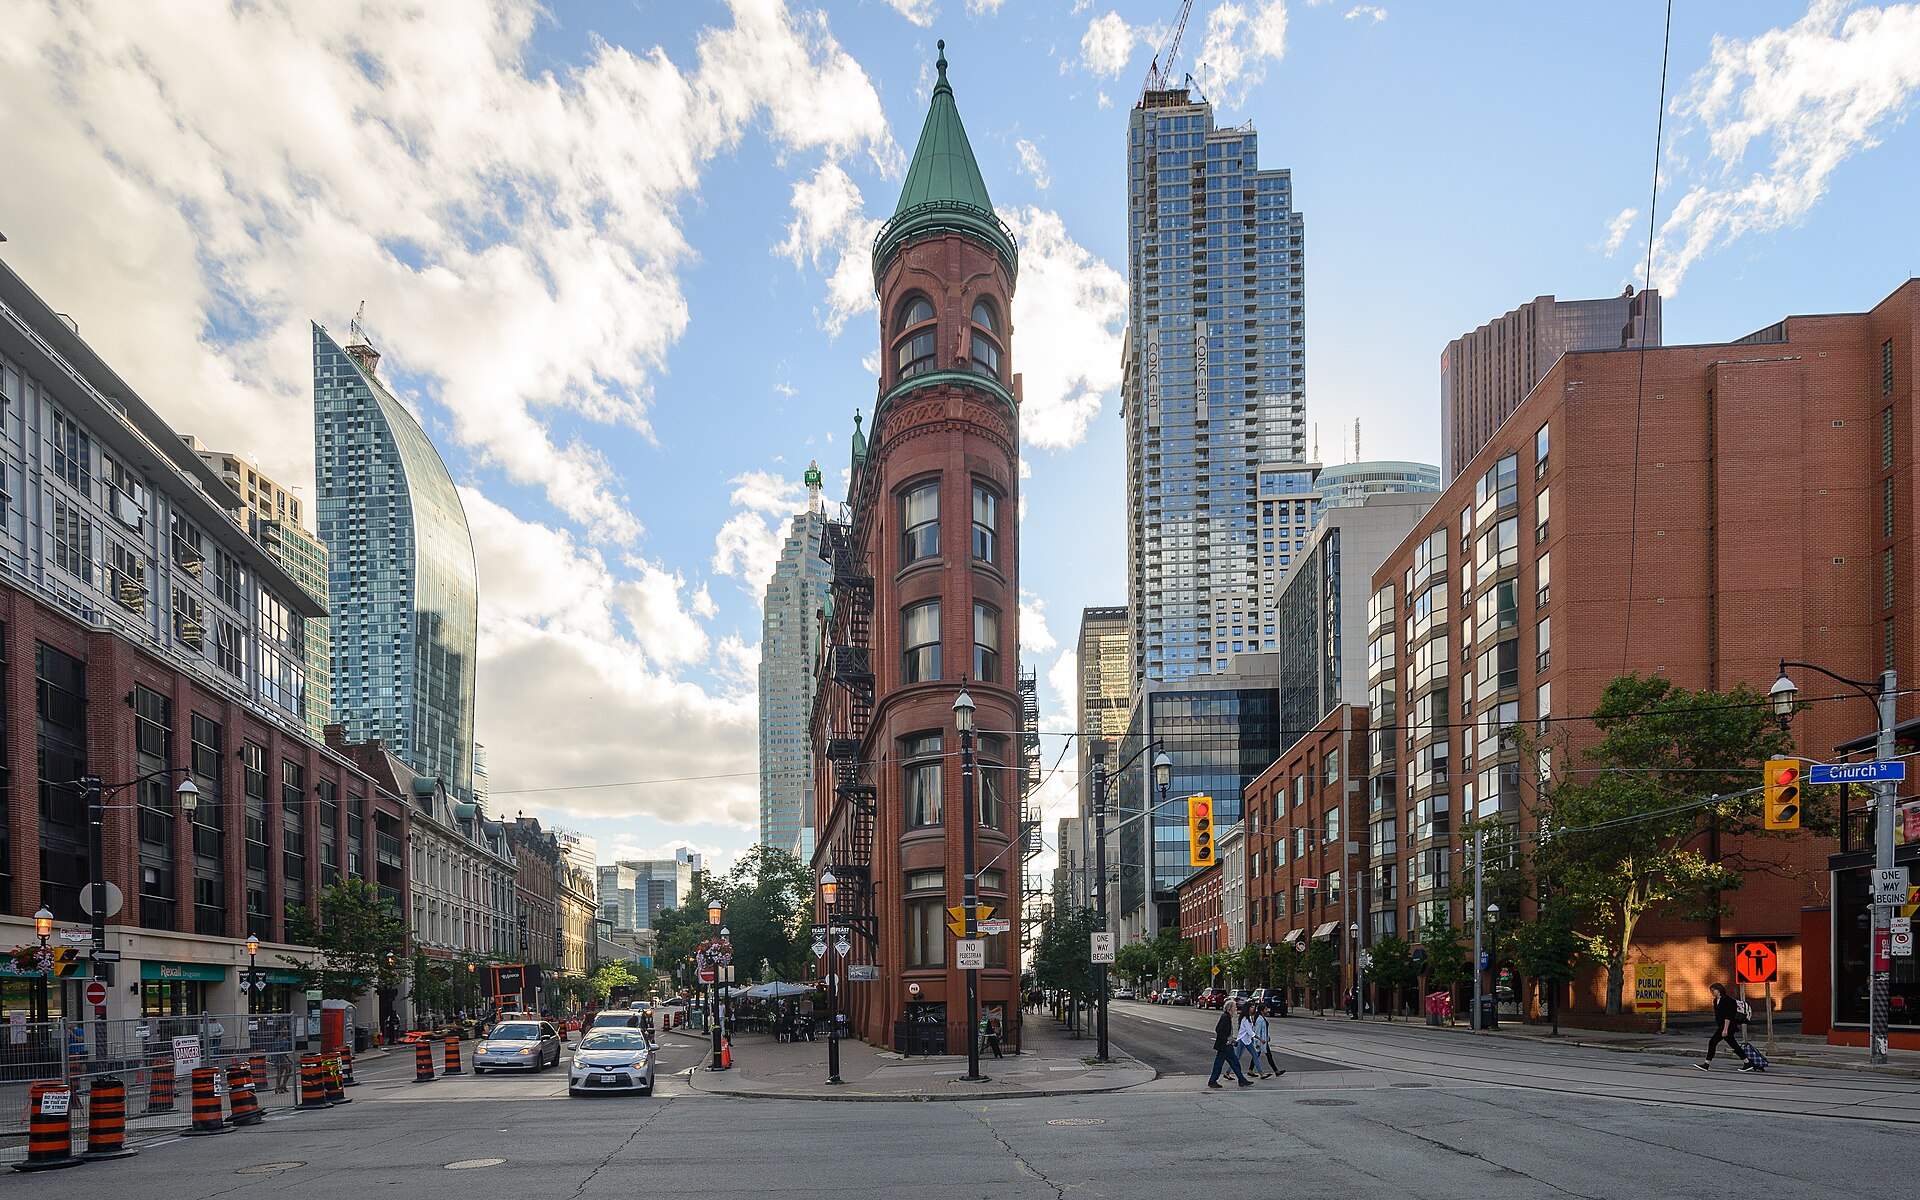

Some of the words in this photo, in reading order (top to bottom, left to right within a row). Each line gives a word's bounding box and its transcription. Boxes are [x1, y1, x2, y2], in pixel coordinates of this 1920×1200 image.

[1197, 335, 1206, 404] CONCERT
[1149, 342, 1158, 410] CONCERT
[1829, 765, 1877, 779] Church
[1881, 870, 1900, 880] ONE
[1883, 882, 1900, 891] WAY
[1876, 893, 1905, 904] BEGINS
[965, 943, 976, 951] NO
[1092, 952, 1114, 960] BEGINS
[160, 965, 182, 978] Rexall
[1638, 978, 1662, 988] PUBLIC
[1635, 990, 1665, 999] PARKING
[175, 1046, 199, 1059] DANGER
